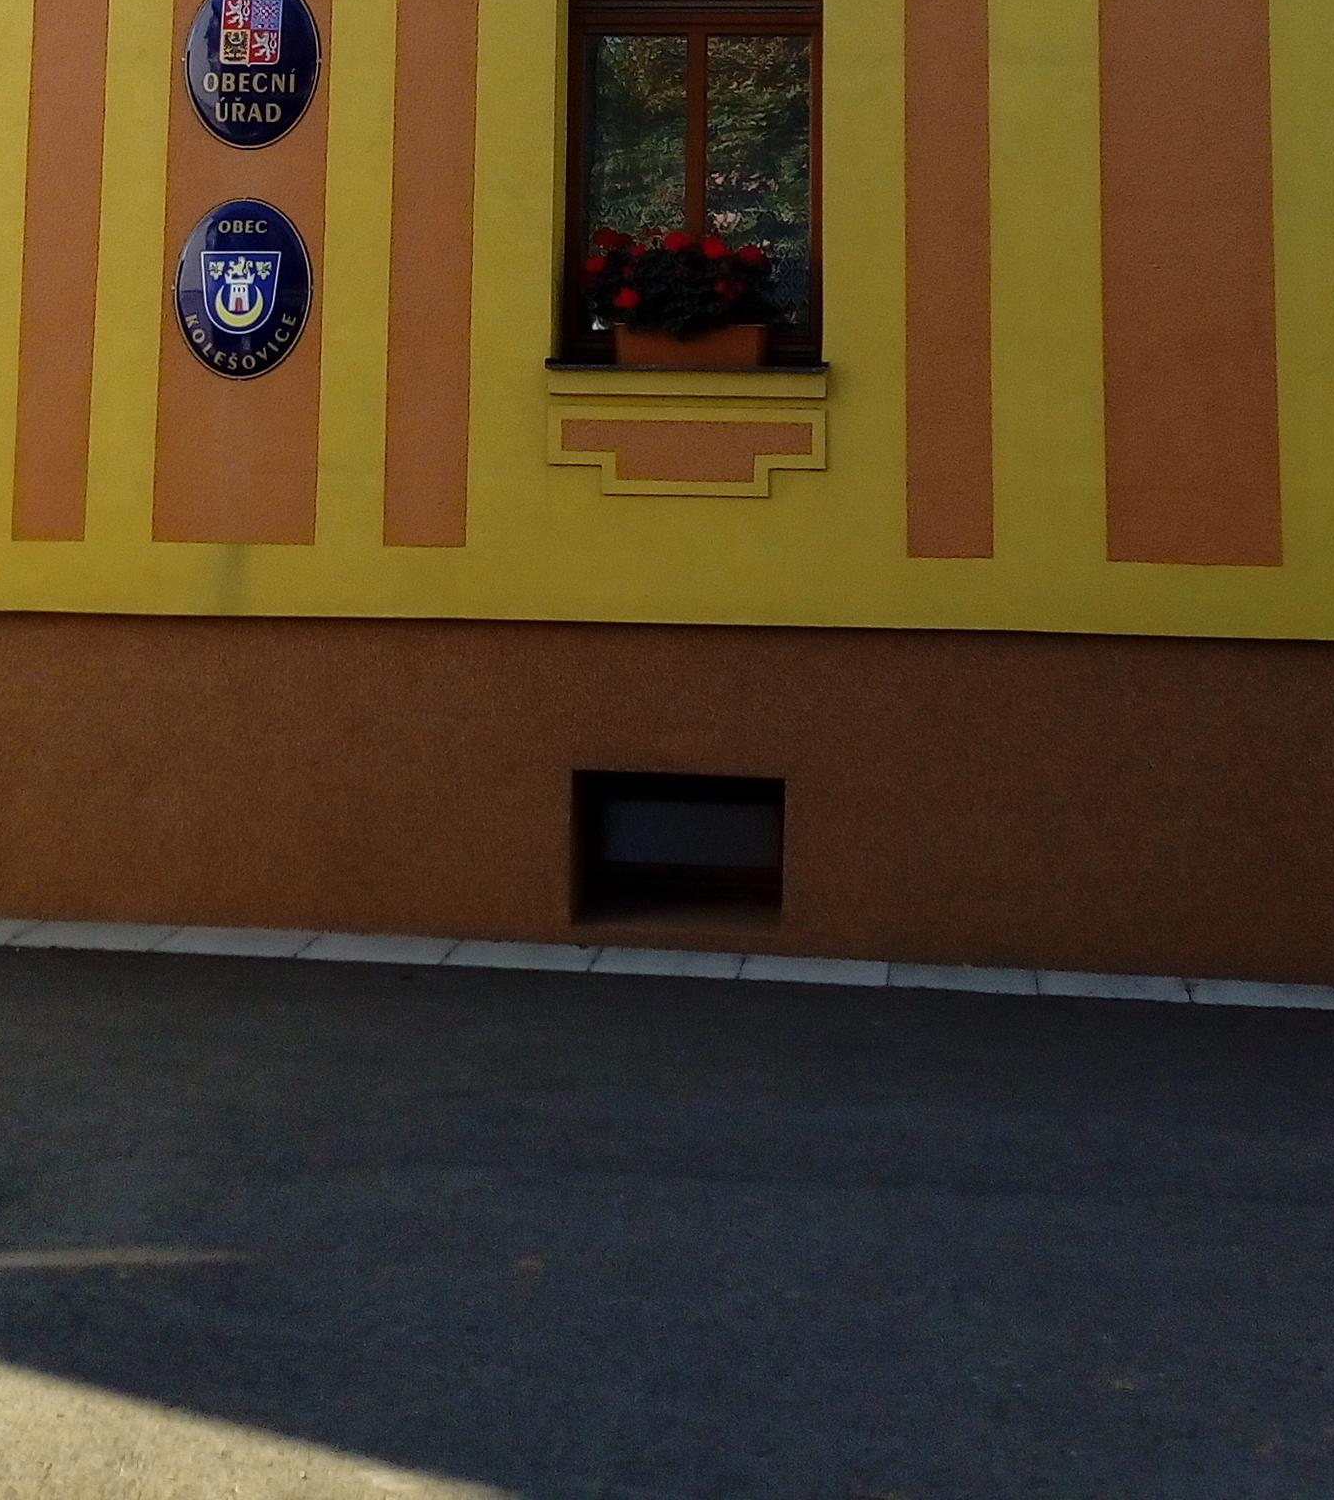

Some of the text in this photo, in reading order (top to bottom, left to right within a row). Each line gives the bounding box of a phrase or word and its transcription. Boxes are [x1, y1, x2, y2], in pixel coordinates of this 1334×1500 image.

[203, 68, 296, 93] OBECNÍ
[215, 97, 282, 123] ÚŘAD
[218, 220, 268, 234] OBEC
[185, 313, 297, 370] KOLEŠOVICE
